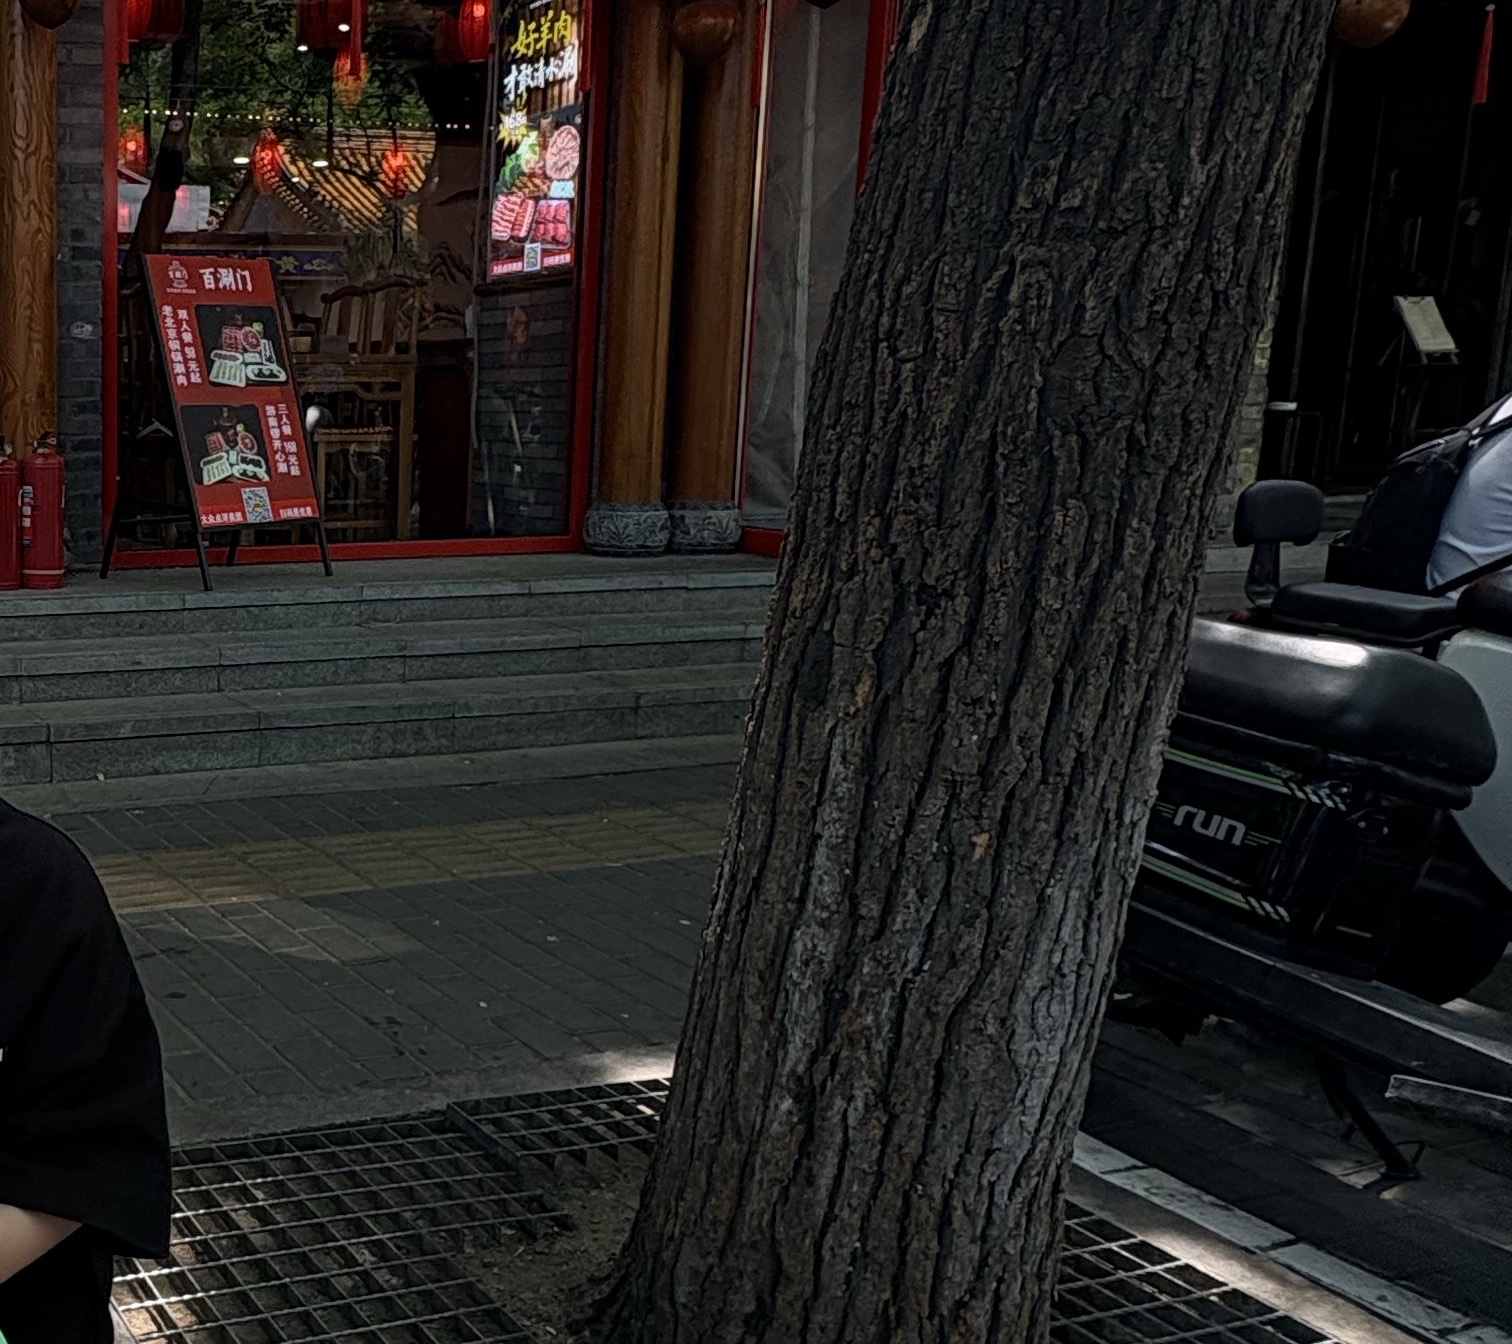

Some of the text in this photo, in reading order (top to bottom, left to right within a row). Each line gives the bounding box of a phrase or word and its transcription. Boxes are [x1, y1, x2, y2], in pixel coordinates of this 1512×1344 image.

[510, 9, 573, 59] 好羊肉
[199, 266, 253, 293] 百涮门
[1173, 805, 1246, 846] run
